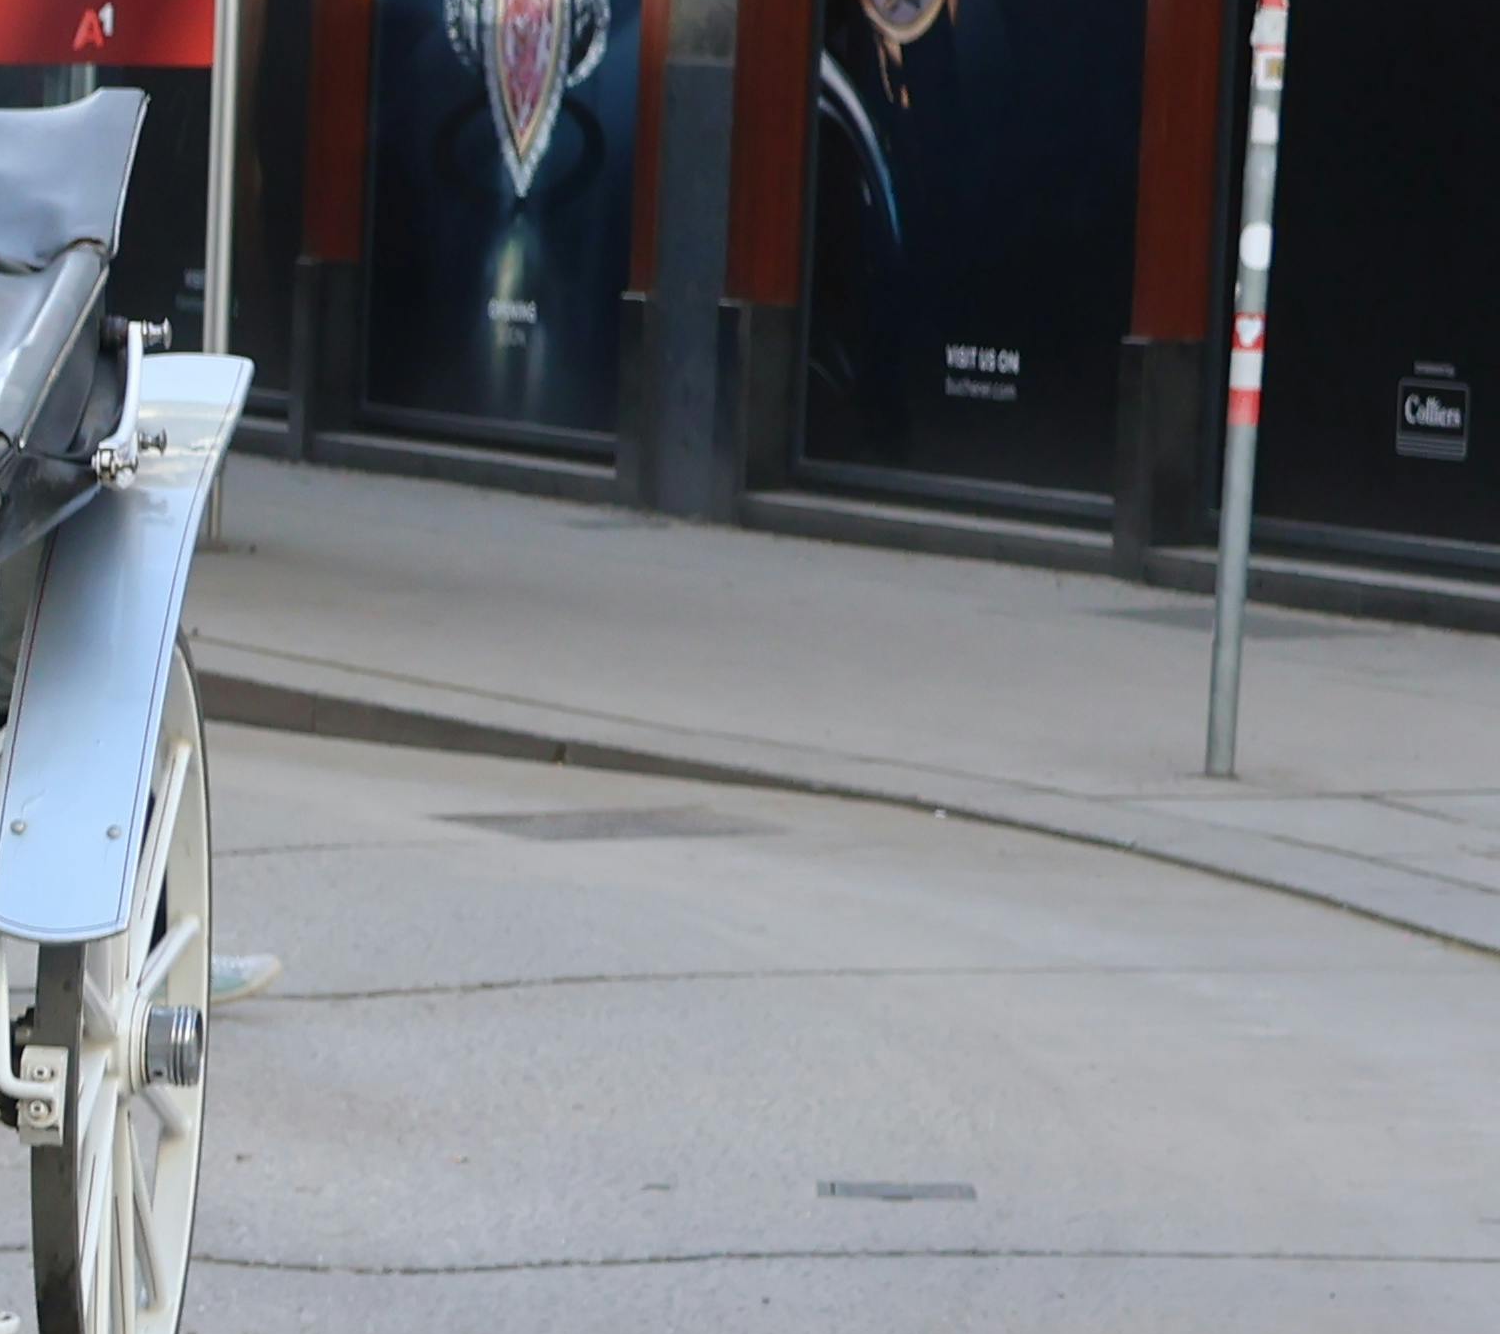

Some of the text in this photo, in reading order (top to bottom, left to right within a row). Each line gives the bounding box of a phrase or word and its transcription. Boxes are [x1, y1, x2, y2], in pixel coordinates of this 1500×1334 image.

[73, 1, 115, 51] A1
[945, 344, 1020, 375] VISIT US ON
[1404, 392, 1461, 428] Colliers
